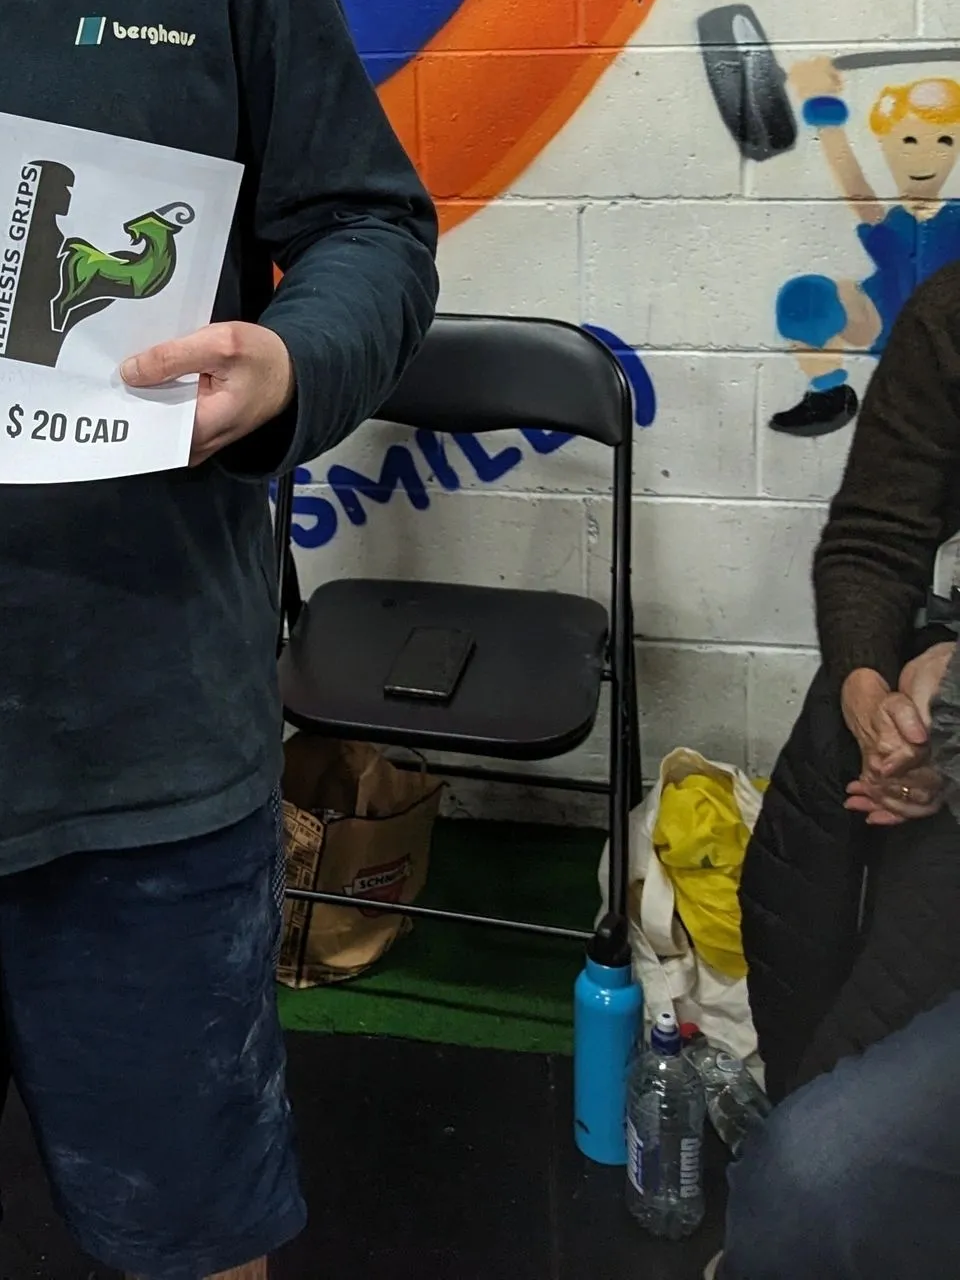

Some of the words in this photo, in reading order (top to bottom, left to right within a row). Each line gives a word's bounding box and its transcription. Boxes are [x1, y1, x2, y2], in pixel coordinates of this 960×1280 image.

[112, 21, 197, 47] berghaus
[8, 165, 39, 242] GRIPS
[31, 409, 68, 442] 20
[74, 416, 130, 444] CAD
